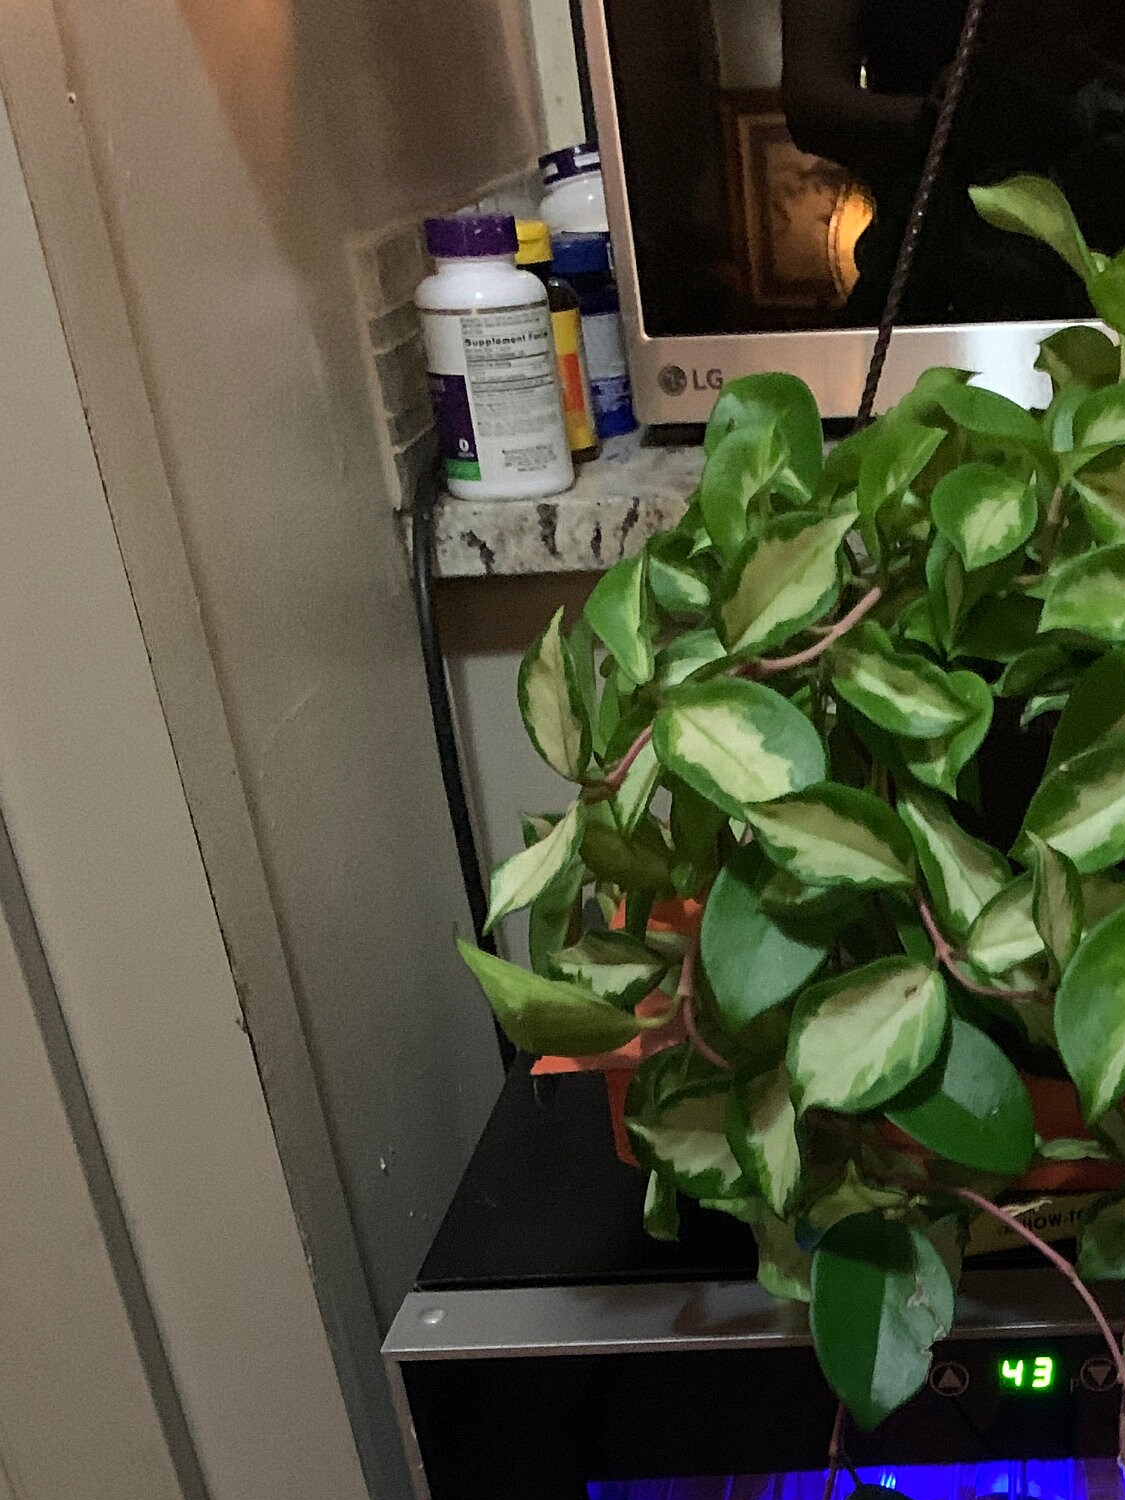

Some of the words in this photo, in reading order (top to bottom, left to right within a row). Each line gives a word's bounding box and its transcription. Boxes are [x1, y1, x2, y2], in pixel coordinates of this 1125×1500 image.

[464, 333, 526, 347] Supplement
[692, 368, 724, 391] LG
[1001, 1356, 1054, 1389] 43
